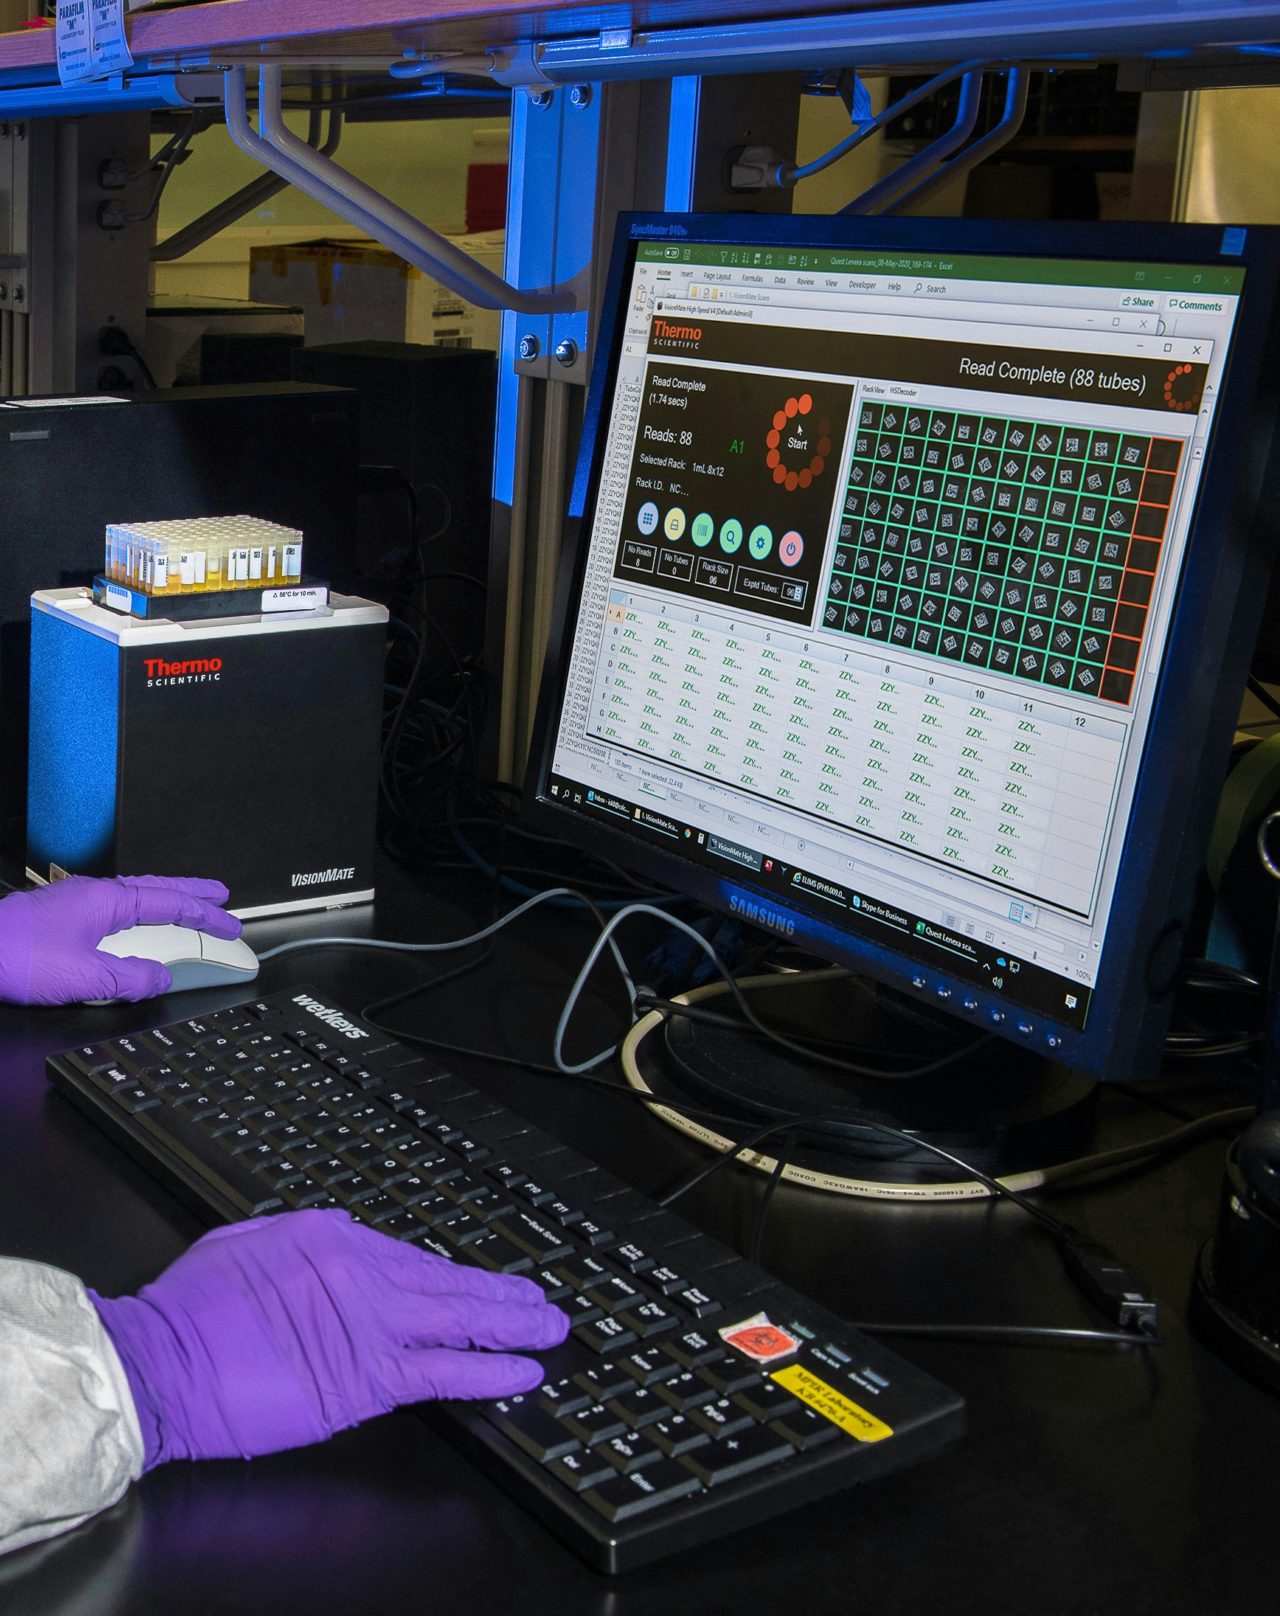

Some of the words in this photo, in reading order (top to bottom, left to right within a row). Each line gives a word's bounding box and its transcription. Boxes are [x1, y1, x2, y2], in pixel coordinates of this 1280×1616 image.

[60, 2, 85, 20] PARAFILM
[938, 262, 953, 271] Excel
[639, 267, 647, 275] File
[703, 271, 715, 281] Page
[715, 273, 732, 282] Layout
[742, 274, 764, 283] Formulas
[774, 276, 786, 284] Data
[796, 277, 815, 286] Review
[825, 279, 838, 288] View
[848, 280, 877, 291] Developer
[887, 282, 902, 292] Help
[926, 285, 947, 294] Search
[1132, 297, 1155, 308] Share
[1178, 299, 1223, 313] Comments
[654, 320, 703, 341] Thermo
[653, 338, 700, 350] SCIENTIFIC
[652, 375, 672, 387] Read
[672, 377, 707, 393] Complete
[959, 357, 996, 378] Read
[998, 361, 1066, 385] Complete
[1069, 367, 1095, 390] (88
[1097, 371, 1147, 397] tubes)
[648, 392, 667, 408] (1.74
[667, 395, 688, 410] secs)
[643, 425, 677, 443] Reads:
[679, 430, 693, 447] 88
[729, 439, 745, 455] A1
[787, 437, 808, 451] Start
[639, 453, 668, 469] Selected
[667, 457, 687, 471] Rack:
[692, 461, 706, 474] 1mL
[706, 464, 725, 477] 8x12
[635, 476, 652, 489] Rack
[635, 557, 641, 567] 8
[664, 553, 672, 563] No
[672, 555, 689, 567] Tubes
[672, 565, 677, 576] 0
[702, 561, 716, 573] Rack
[716, 565, 729, 575] Size
[709, 575, 718, 586] 96
[760, 581, 780, 595] Tubes:
[143, 657, 222, 678] Thermo
[629, 597, 633, 606] 1
[661, 605, 666, 615] 2
[694, 614, 700, 623] 3
[729, 623, 735, 632] 4
[765, 632, 771, 642] 5
[803, 642, 809, 652] 6
[844, 653, 849, 663] 7
[885, 665, 891, 674] 8
[928, 676, 935, 687] 9
[974, 690, 986, 700] 10
[1023, 703, 1034, 713] 11
[1075, 716, 1087, 728] 12
[147, 673, 221, 688] SCIENTIFIC
[717, 842, 742, 858] VisionMate
[741, 851, 754, 863] High
[729, 895, 796, 936] SAMSUNG
[861, 899, 877, 913] Skype
[876, 907, 886, 917] for
[885, 910, 908, 926] Business
[925, 926, 942, 940] Quest
[941, 934, 962, 948] Lenexa
[292, 994, 368, 1039] wetkeys
[235, 1051, 248, 1059] W
[274, 1080, 286, 1088] R
[237, 1128, 249, 1136] B
[338, 1126, 350, 1134] U
[280, 1162, 293, 1170] M
[328, 1159, 341, 1167] K
[352, 1176, 362, 1184] L
